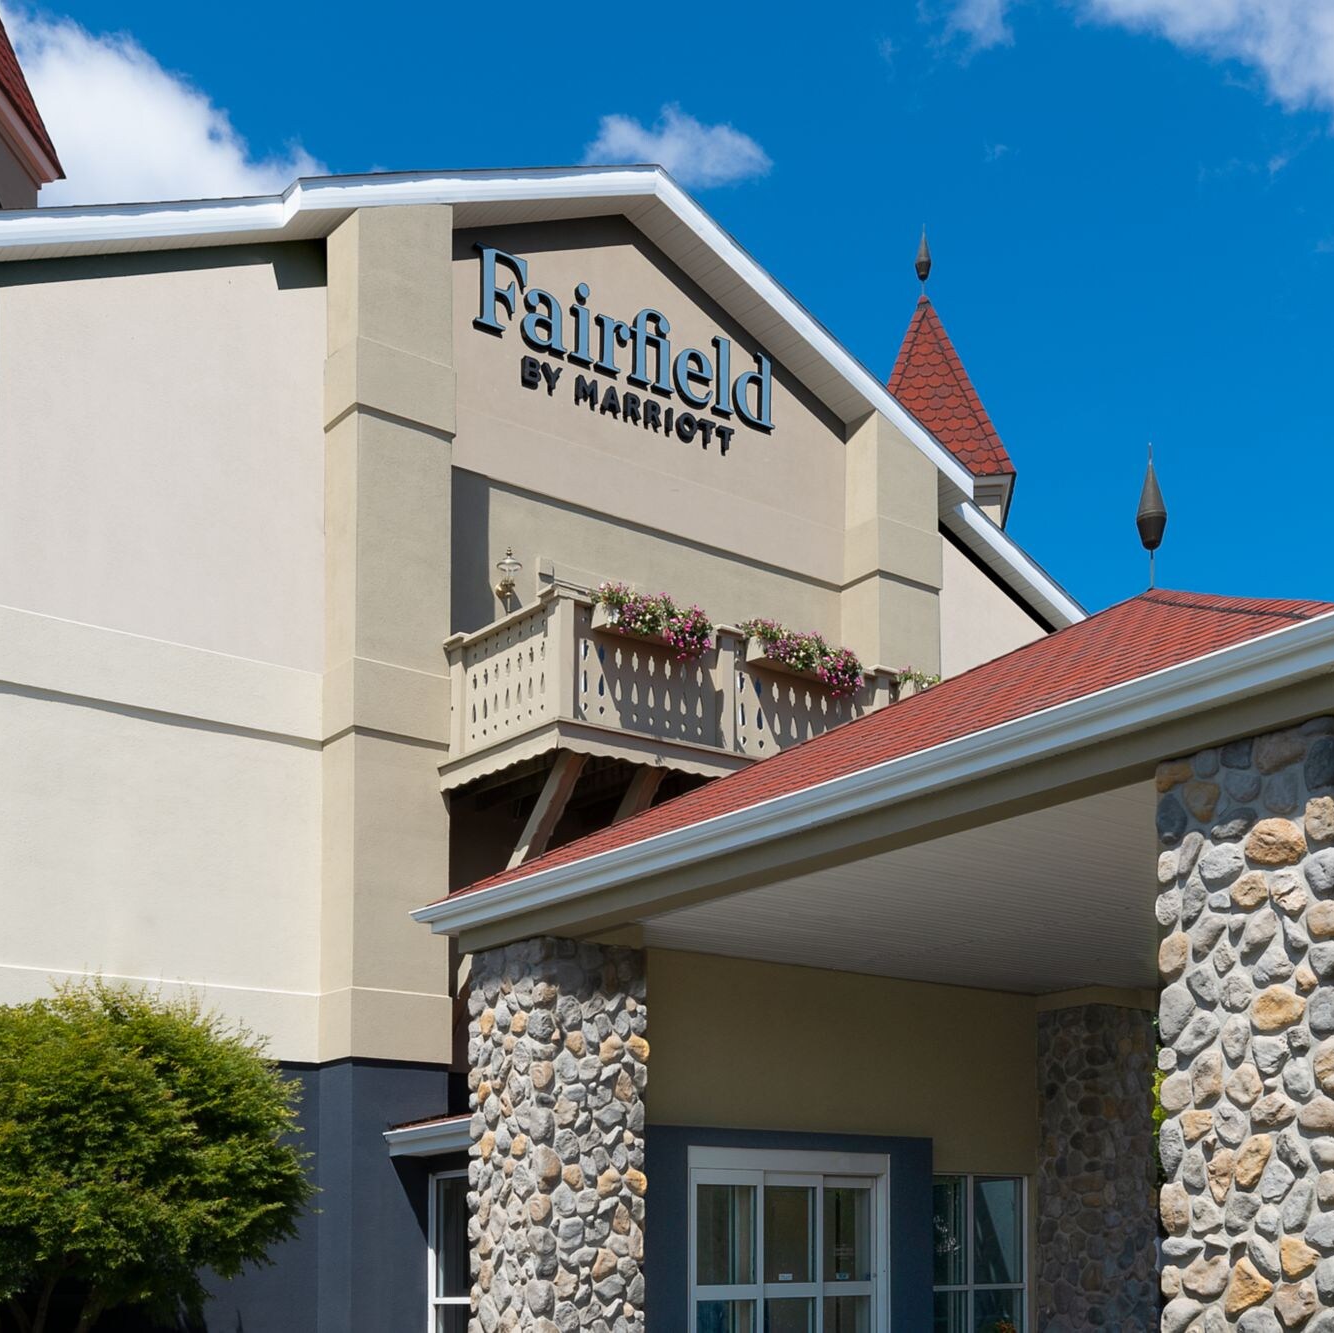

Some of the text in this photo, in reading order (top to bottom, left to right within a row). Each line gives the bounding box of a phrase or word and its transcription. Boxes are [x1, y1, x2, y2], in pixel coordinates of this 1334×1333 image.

[473, 242, 775, 435] Fairfield
[521, 355, 735, 456] BY MARRIOTT
